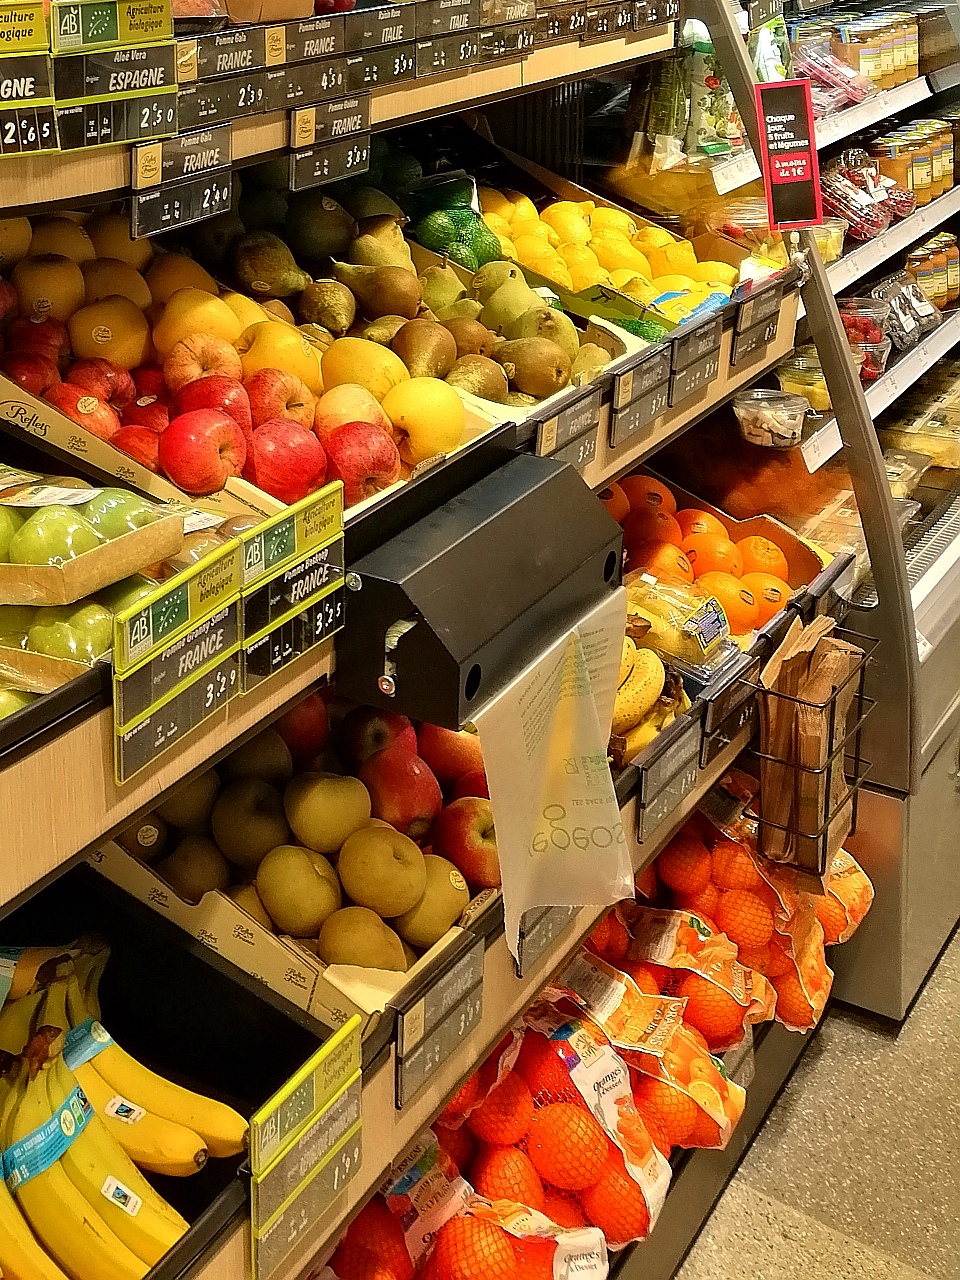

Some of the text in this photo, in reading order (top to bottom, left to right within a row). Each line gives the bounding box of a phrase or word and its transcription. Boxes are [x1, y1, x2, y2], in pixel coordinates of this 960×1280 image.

[126, 3, 165, 19] Agriculture
[449, 13, 469, 31] ITALIE
[128, 19, 163, 32] biologique
[381, 24, 404, 43] ITALIE
[131, 49, 147, 61] Vera
[304, 36, 336, 57] FRANCE
[217, 49, 253, 72] FRANCE
[109, 67, 165, 91] ESPAGNE
[331, 115, 362, 136] FRANCE
[765, 114, 796, 124] Chaque
[183, 149, 220, 173] FRANCE
[302, 498, 337, 524] Agriculture
[304, 513, 335, 538] biologique
[197, 555, 236, 588] Agriculture
[199, 573, 234, 603] biologique
[290, 564, 330, 604] FRANCE
[178, 629, 224, 677] FRANCE
[592, 1066, 623, 1094] Oranges
